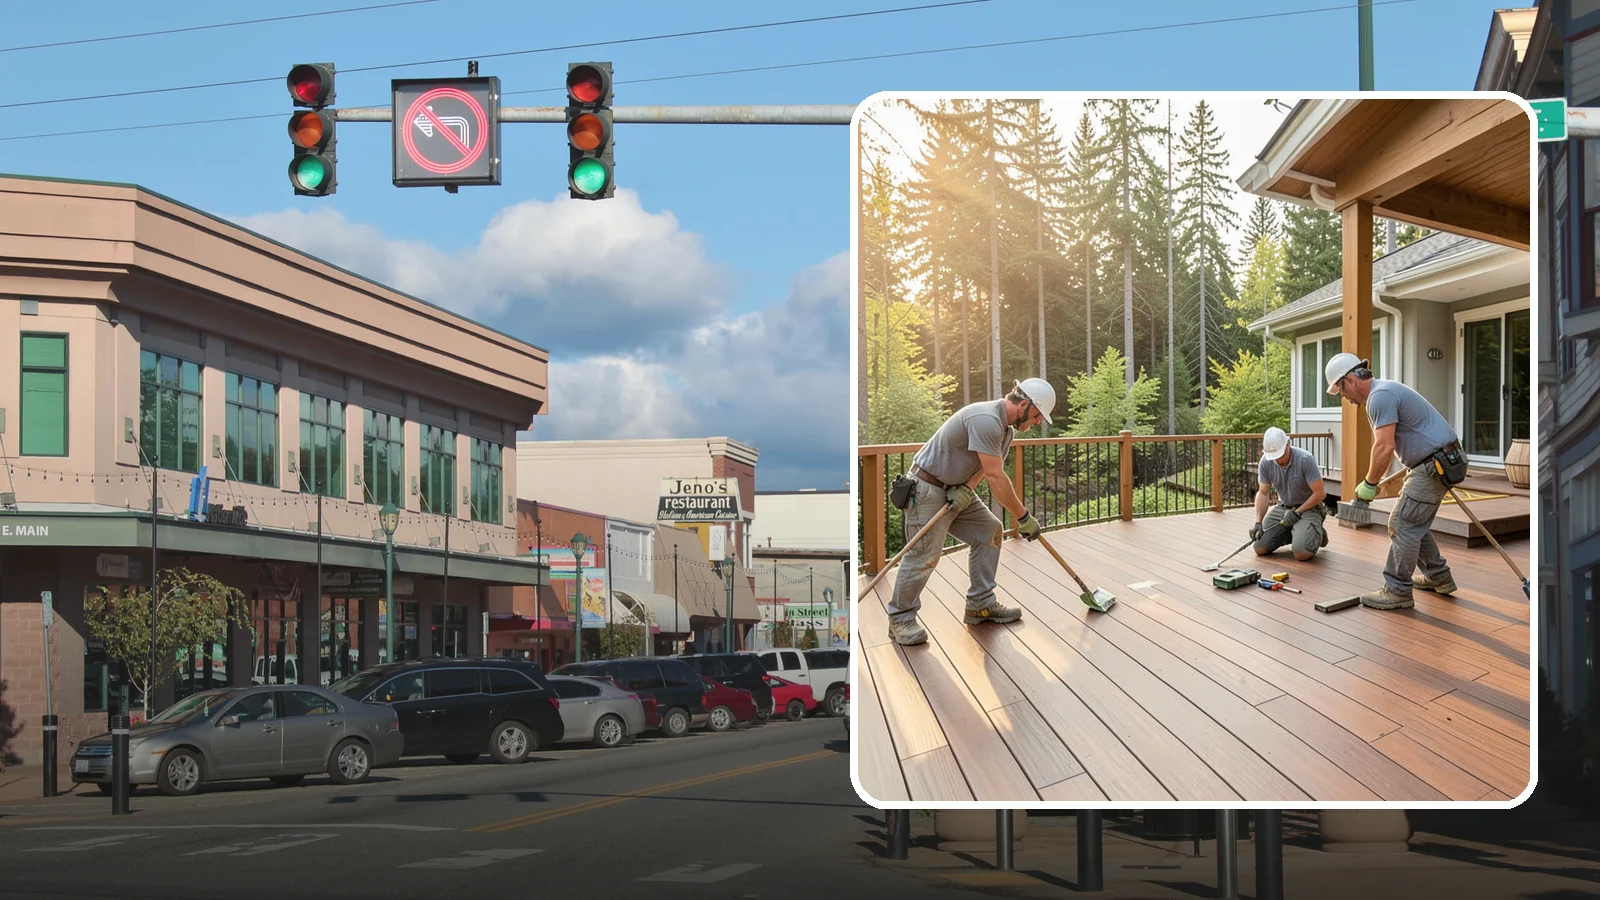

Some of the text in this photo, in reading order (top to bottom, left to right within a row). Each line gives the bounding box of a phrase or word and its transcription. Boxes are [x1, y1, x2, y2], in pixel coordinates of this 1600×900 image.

[669, 480, 727, 494] Jeno's
[665, 496, 731, 509] restaurant
[658, 509, 681, 520] Italian
[686, 509, 714, 519] American
[715, 509, 738, 519] Cuisine
[2, 525, 49, 536] E. MAIN
[786, 608, 828, 616] in Street
[791, 619, 823, 627] lass
